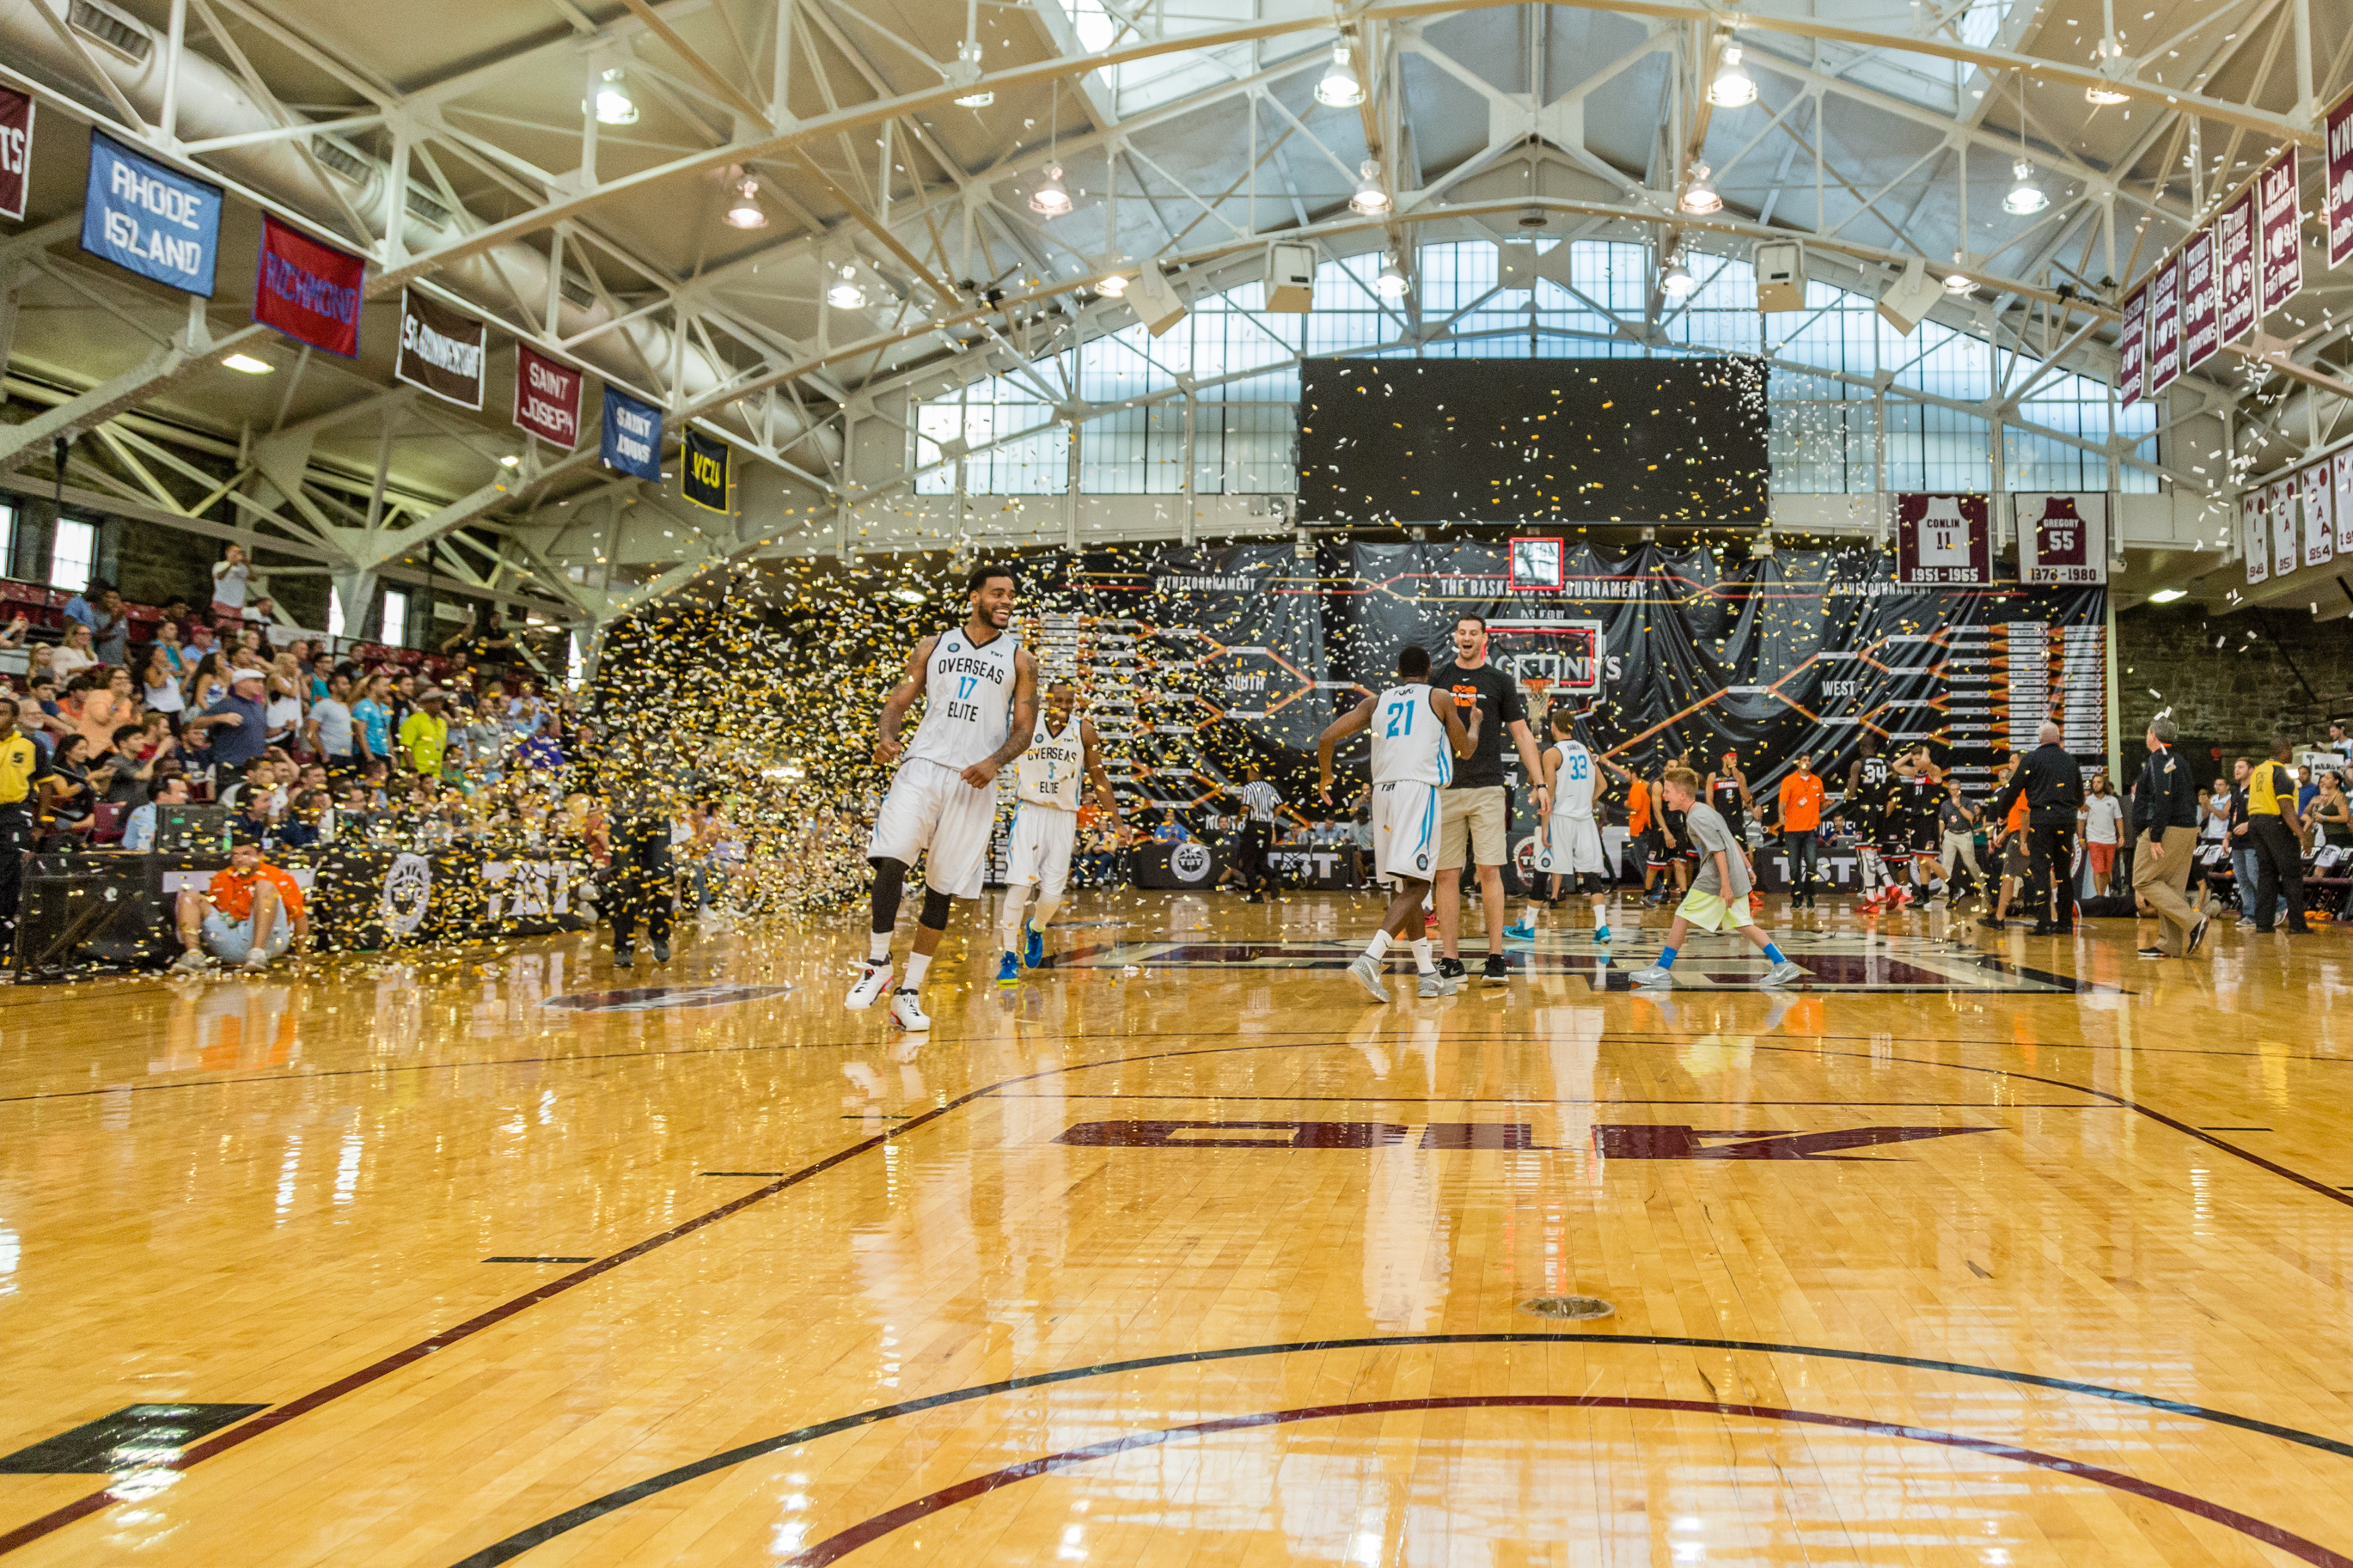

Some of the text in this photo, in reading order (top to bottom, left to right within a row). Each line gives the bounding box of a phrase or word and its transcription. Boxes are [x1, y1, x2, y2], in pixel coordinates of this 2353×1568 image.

[112, 161, 201, 230] RHODE
[104, 207, 201, 275] ISLAND
[266, 251, 355, 323] RICHMOND
[529, 362, 569, 400] SAINT
[521, 397, 574, 436] JOSEPH
[616, 406, 651, 437] SAINT
[616, 433, 651, 464] LOUIS
[694, 451, 721, 488] VCU
[1927, 518, 1960, 528] CONLIN
[2043, 518, 2079, 528] GREGORY
[1937, 532, 1952, 550] 11
[2049, 530, 2075, 551] 55
[1911, 568, 1978, 583] 1951-1955
[1440, 579, 1464, 595] THE
[938, 658, 1004, 685] OVERSEAS
[1225, 674, 1265, 691] SOUTH
[957, 676, 978, 699] 17
[1822, 680, 1855, 697] WEST
[947, 701, 979, 723] ELITE
[1386, 699, 1415, 740] 21
[1027, 747, 1077, 764] OVERSEAS
[1048, 761, 1055, 780] 3
[1569, 755, 1587, 779] 33
[1862, 765, 1887, 784] 34
[1040, 781, 1058, 794] ELITE
[1727, 789, 1733, 798] 2
[1268, 852, 1338, 878] TBT
